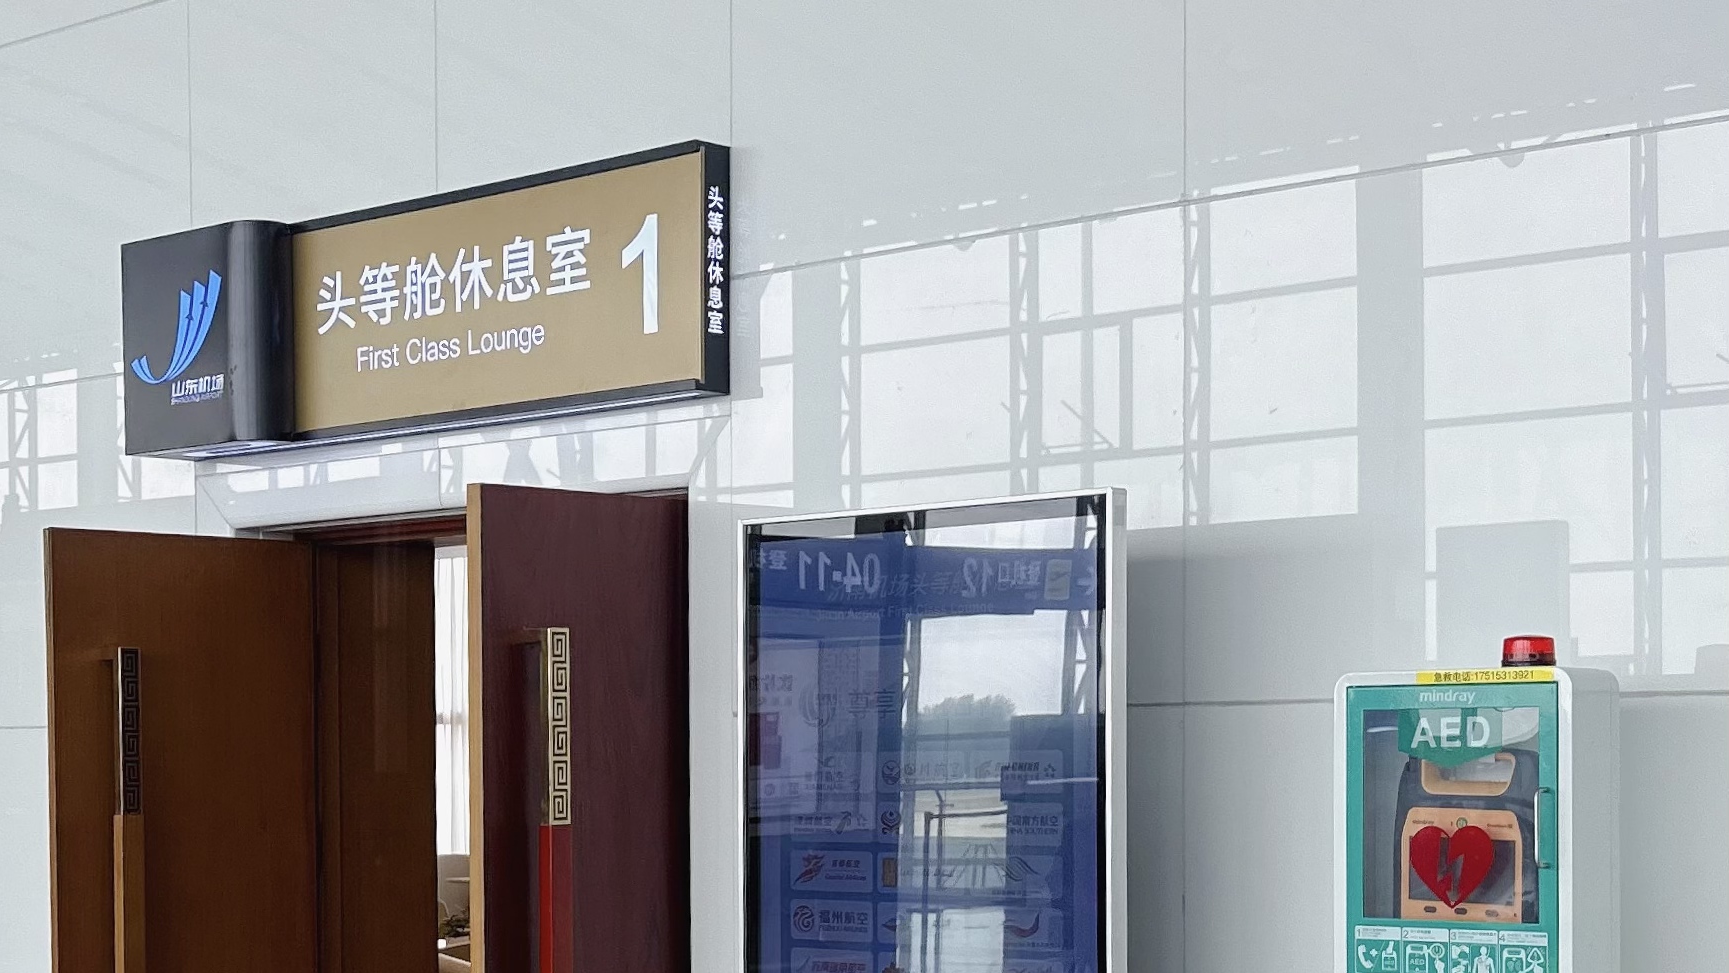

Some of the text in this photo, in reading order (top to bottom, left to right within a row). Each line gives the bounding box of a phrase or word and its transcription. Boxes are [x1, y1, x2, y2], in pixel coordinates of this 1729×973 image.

[621, 213, 659, 335] 1
[708, 185, 725, 335] 头等舱休息室
[315, 226, 592, 336] 头等舱休息室
[356, 324, 546, 373] First Class Lounge
[171, 373, 225, 398] 山东机场
[848, 689, 897, 720] 尊享
[1419, 689, 1476, 705] mindray
[1410, 716, 1491, 749] AED
[818, 909, 868, 926] 福州航空
